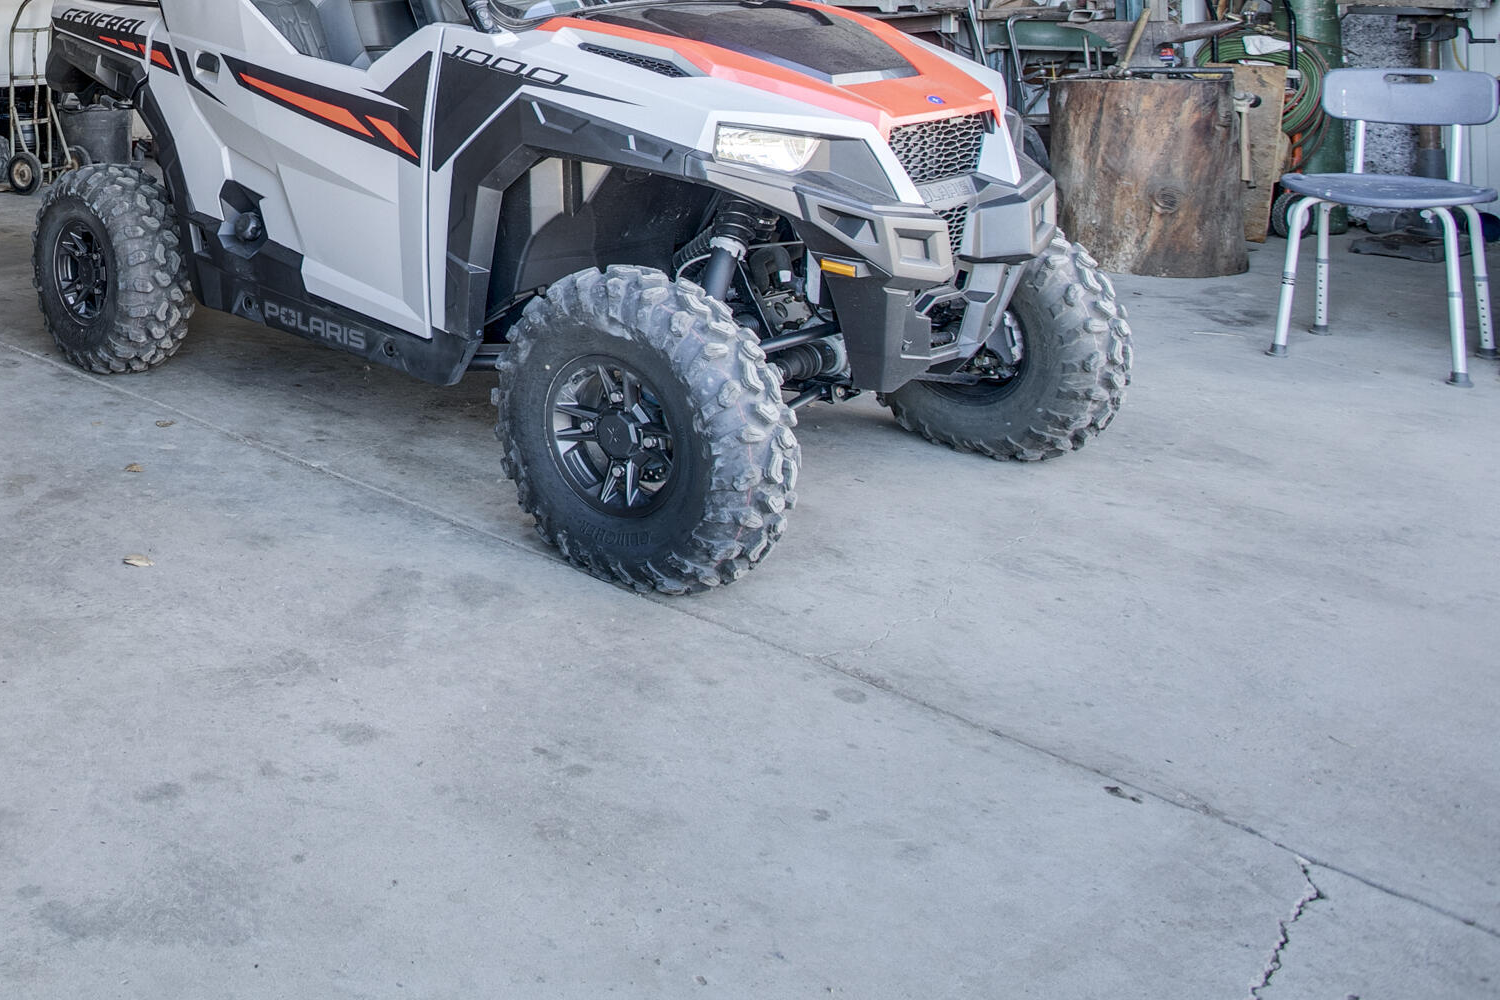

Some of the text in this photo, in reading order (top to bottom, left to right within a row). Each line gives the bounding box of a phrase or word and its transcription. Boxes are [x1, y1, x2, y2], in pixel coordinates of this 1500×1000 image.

[61, 7, 147, 35] GENERAL
[450, 45, 569, 86] 1000
[918, 178, 975, 205] OLARIS
[264, 300, 366, 350] POLARIS
